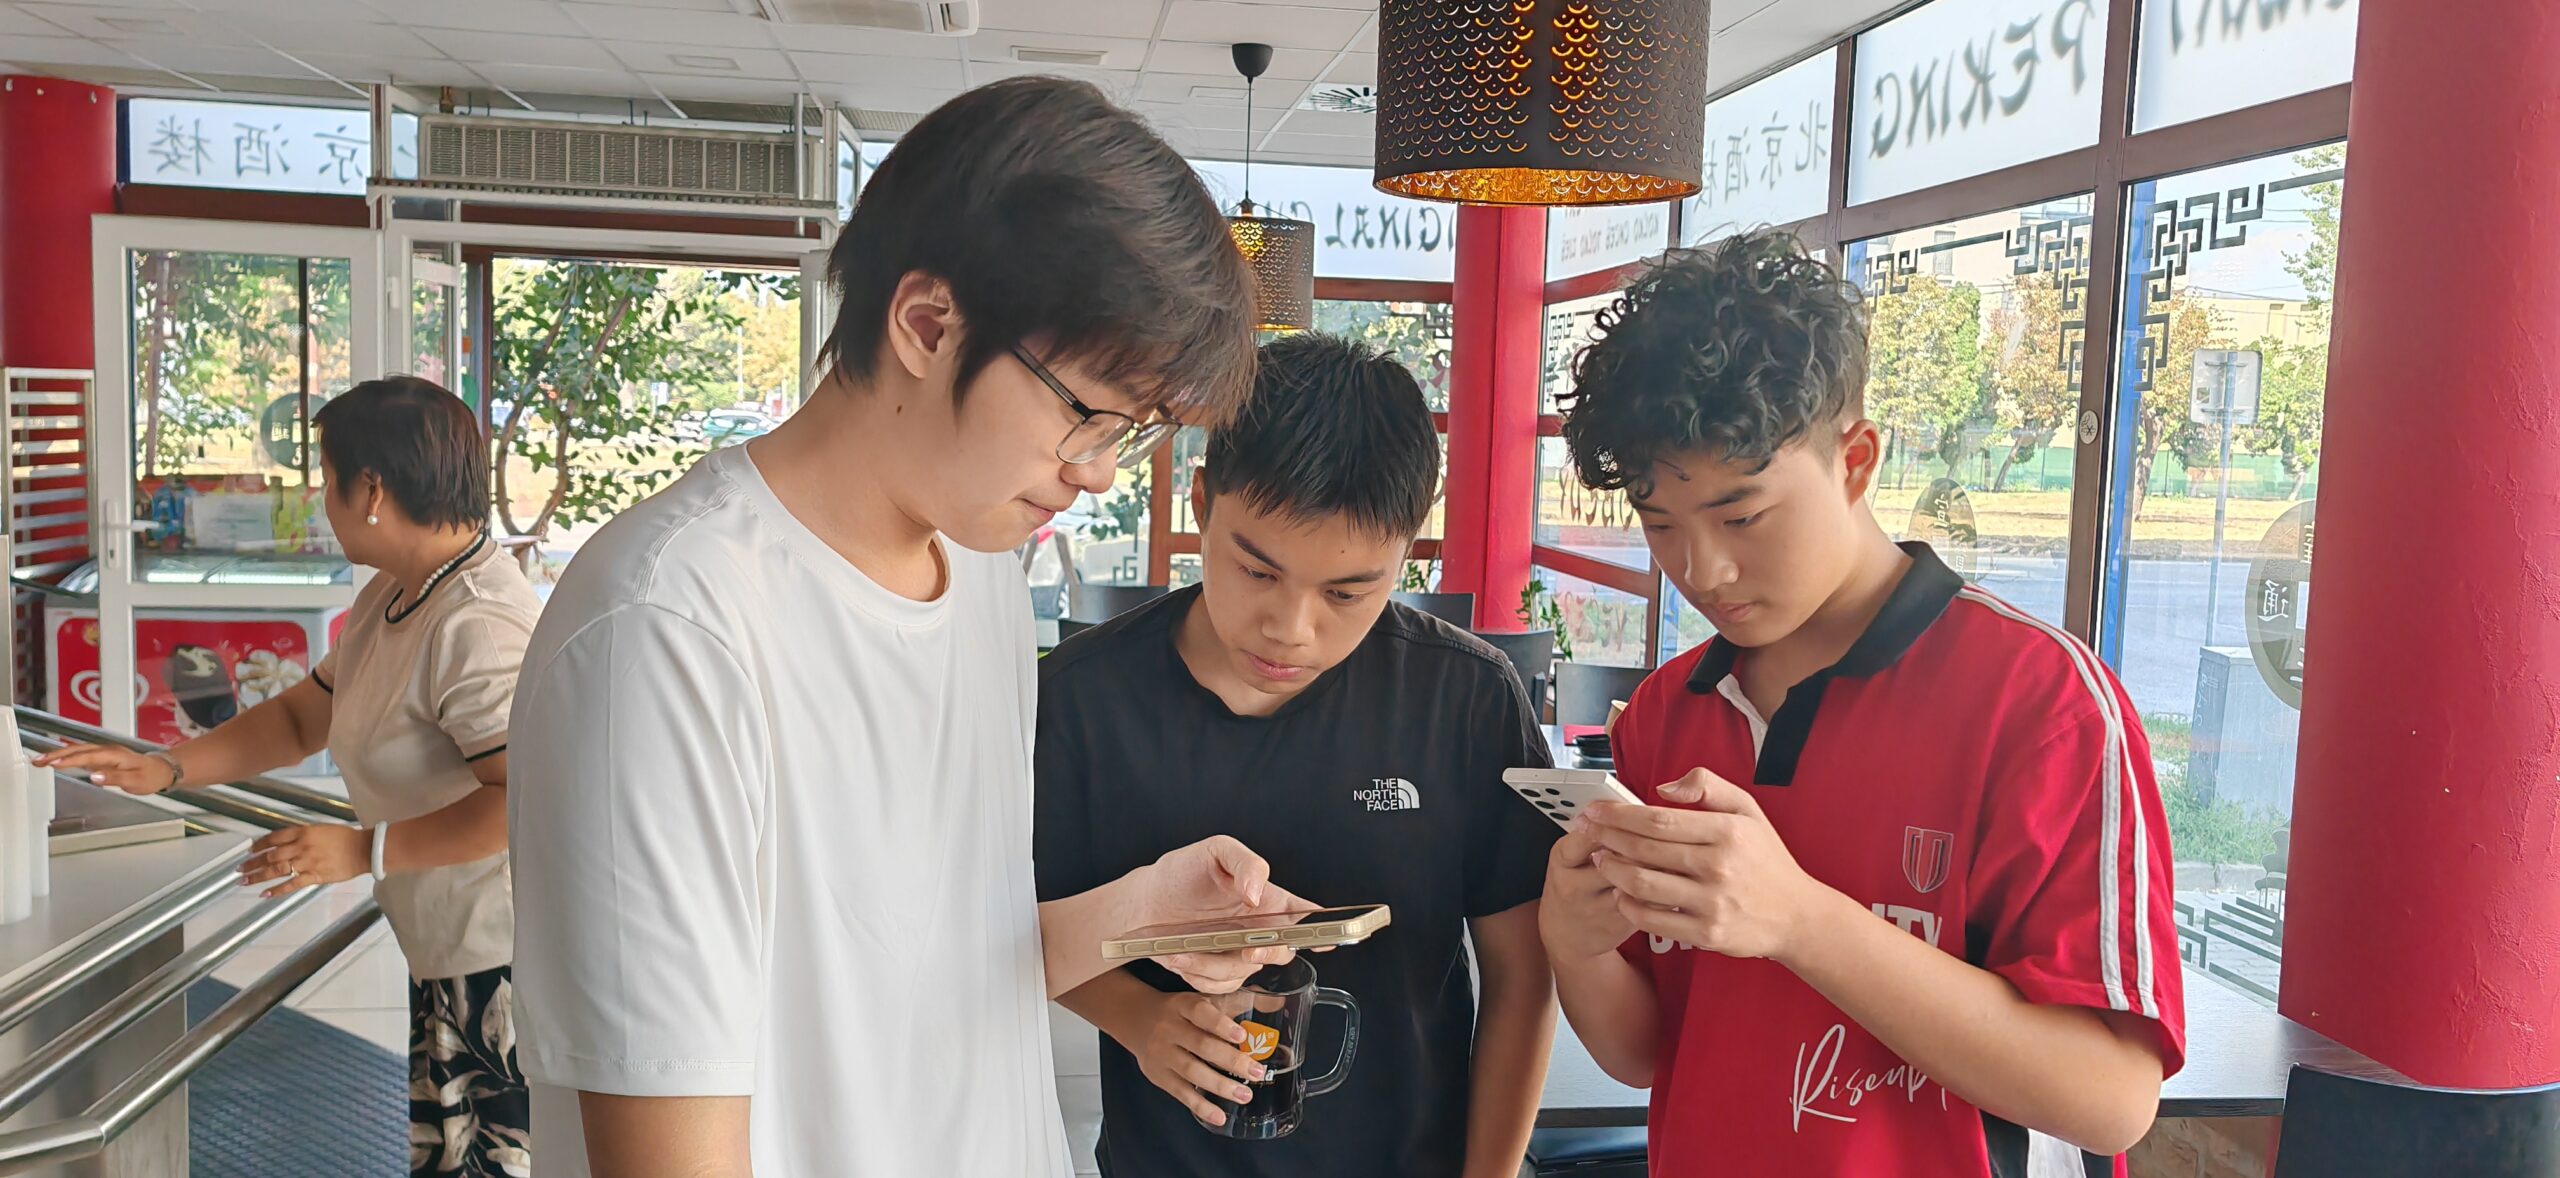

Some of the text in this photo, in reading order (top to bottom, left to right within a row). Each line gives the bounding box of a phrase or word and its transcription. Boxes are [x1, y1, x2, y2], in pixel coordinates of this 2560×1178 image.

[1372, 778, 1397, 790] THE
[1353, 788, 1397, 801] NORTH
[1367, 800, 1398, 812] FACE
